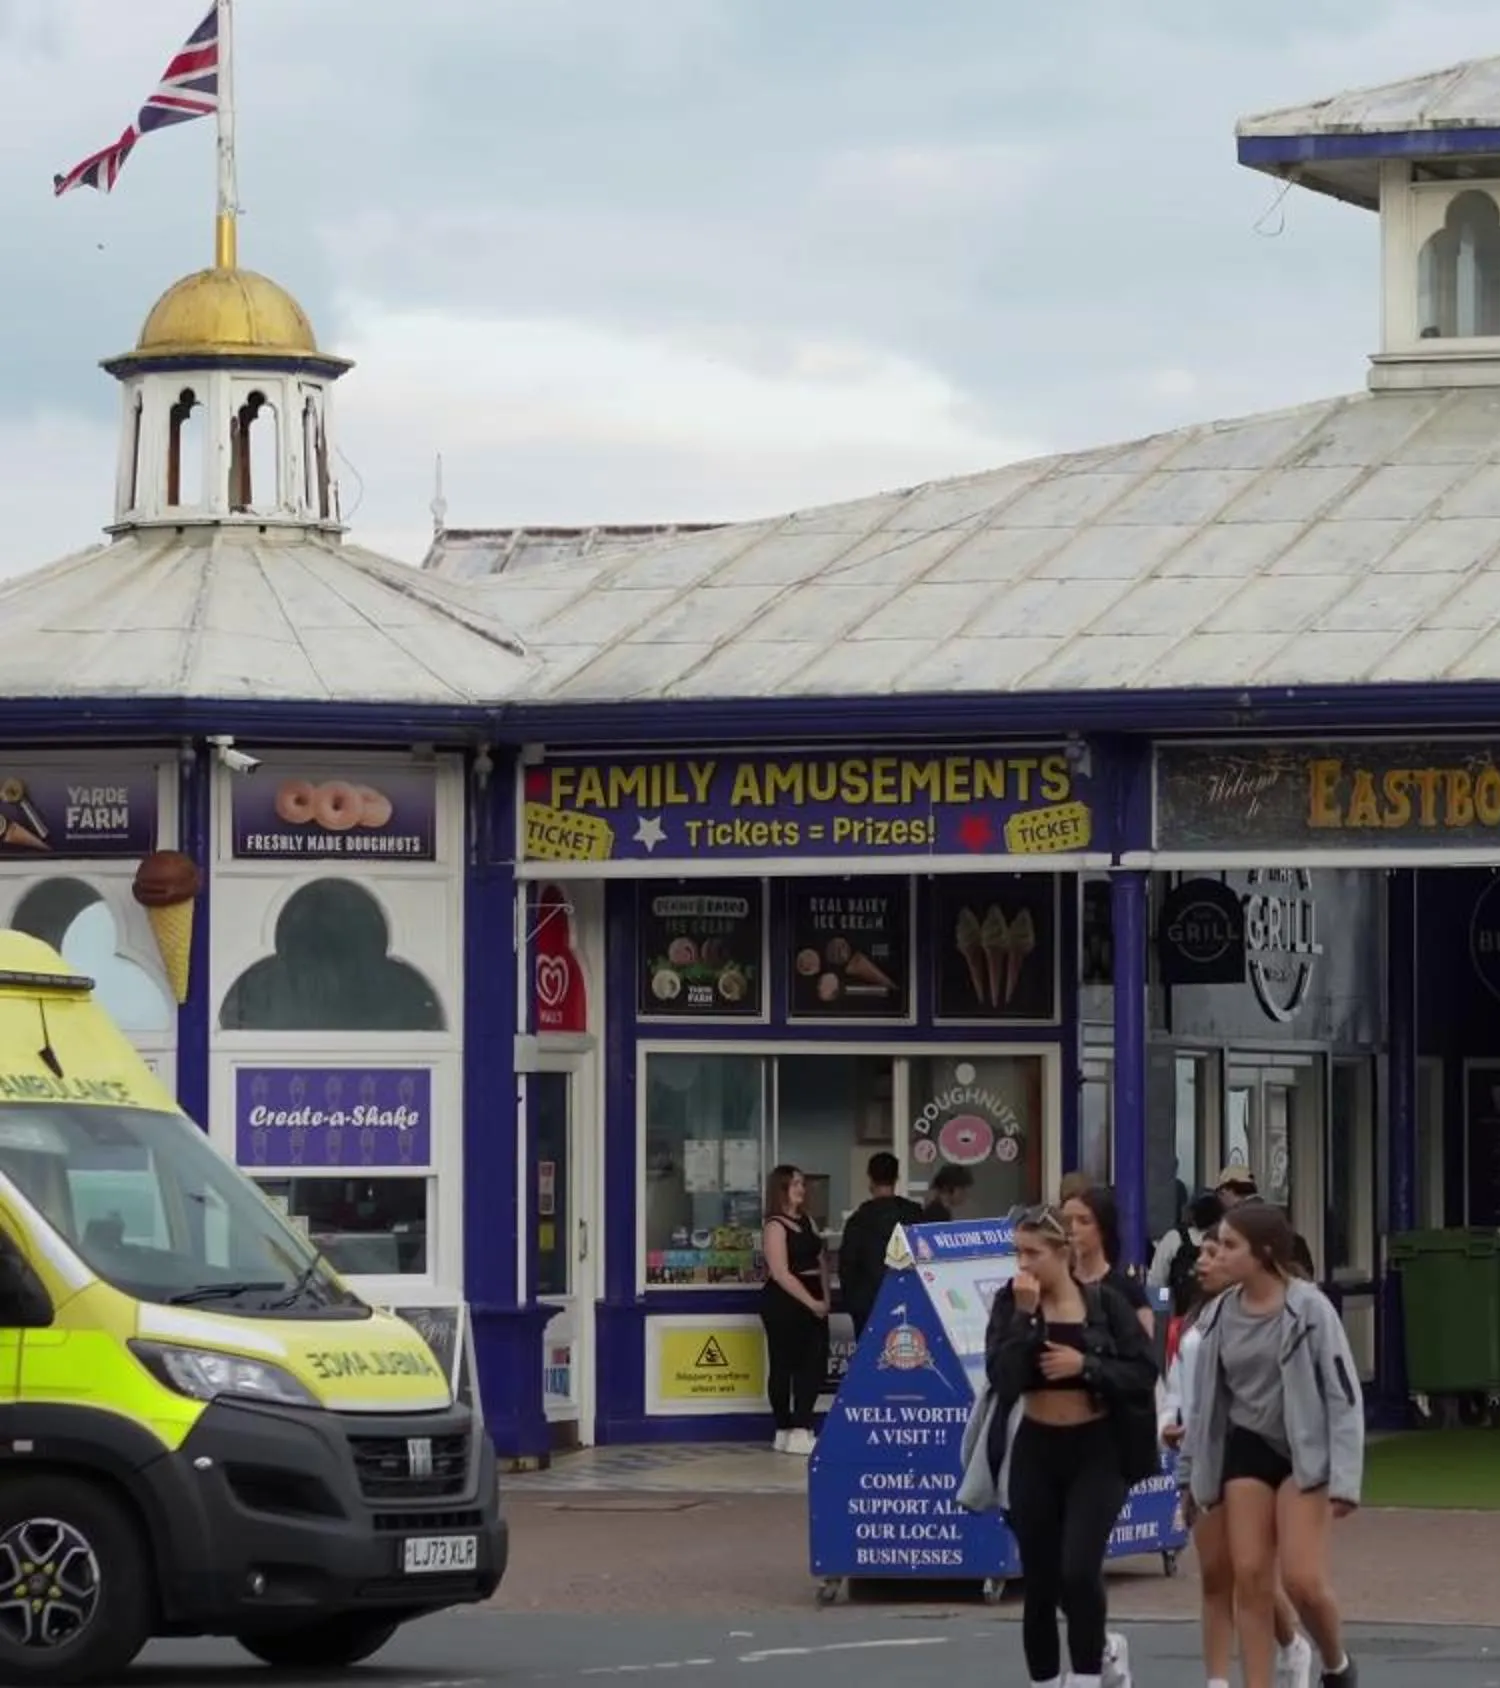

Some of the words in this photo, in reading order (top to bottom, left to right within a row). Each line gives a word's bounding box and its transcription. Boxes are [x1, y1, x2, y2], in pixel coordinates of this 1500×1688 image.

[550, 762, 715, 808] FAMILY
[730, 755, 1072, 806] AMUSEMENTS
[68, 786, 128, 803] YARDE
[67, 807, 128, 830] FARM
[527, 820, 597, 853] TICKET
[685, 819, 799, 847] Tickets
[809, 828, 824, 839] =
[833, 816, 936, 845] Prizes!
[1018, 817, 1081, 844] TICKET
[247, 834, 304, 852] FRESHLY
[307, 835, 343, 852] MADE
[346, 835, 421, 853] DOUGHNUTS
[1168, 921, 1240, 946] GRILL
[1248, 895, 1323, 954] GRILL
[249, 1105, 419, 1131] Create-a-Shake
[914, 1086, 1020, 1137] DOUGHNUTS
[934, 1230, 984, 1249] WELCOME
[845, 1407, 897, 1423] WELL
[900, 1407, 968, 1423] WORTH
[867, 1430, 882, 1445] A
[882, 1429, 930, 1445] VISIT
[860, 1473, 915, 1489] COME
[916, 1473, 956, 1489] AND
[848, 1499, 930, 1515] SUPPORT
[856, 1524, 898, 1540] OUR
[899, 1524, 963, 1540] LOCAL
[856, 1549, 963, 1566] BUSINESSES
